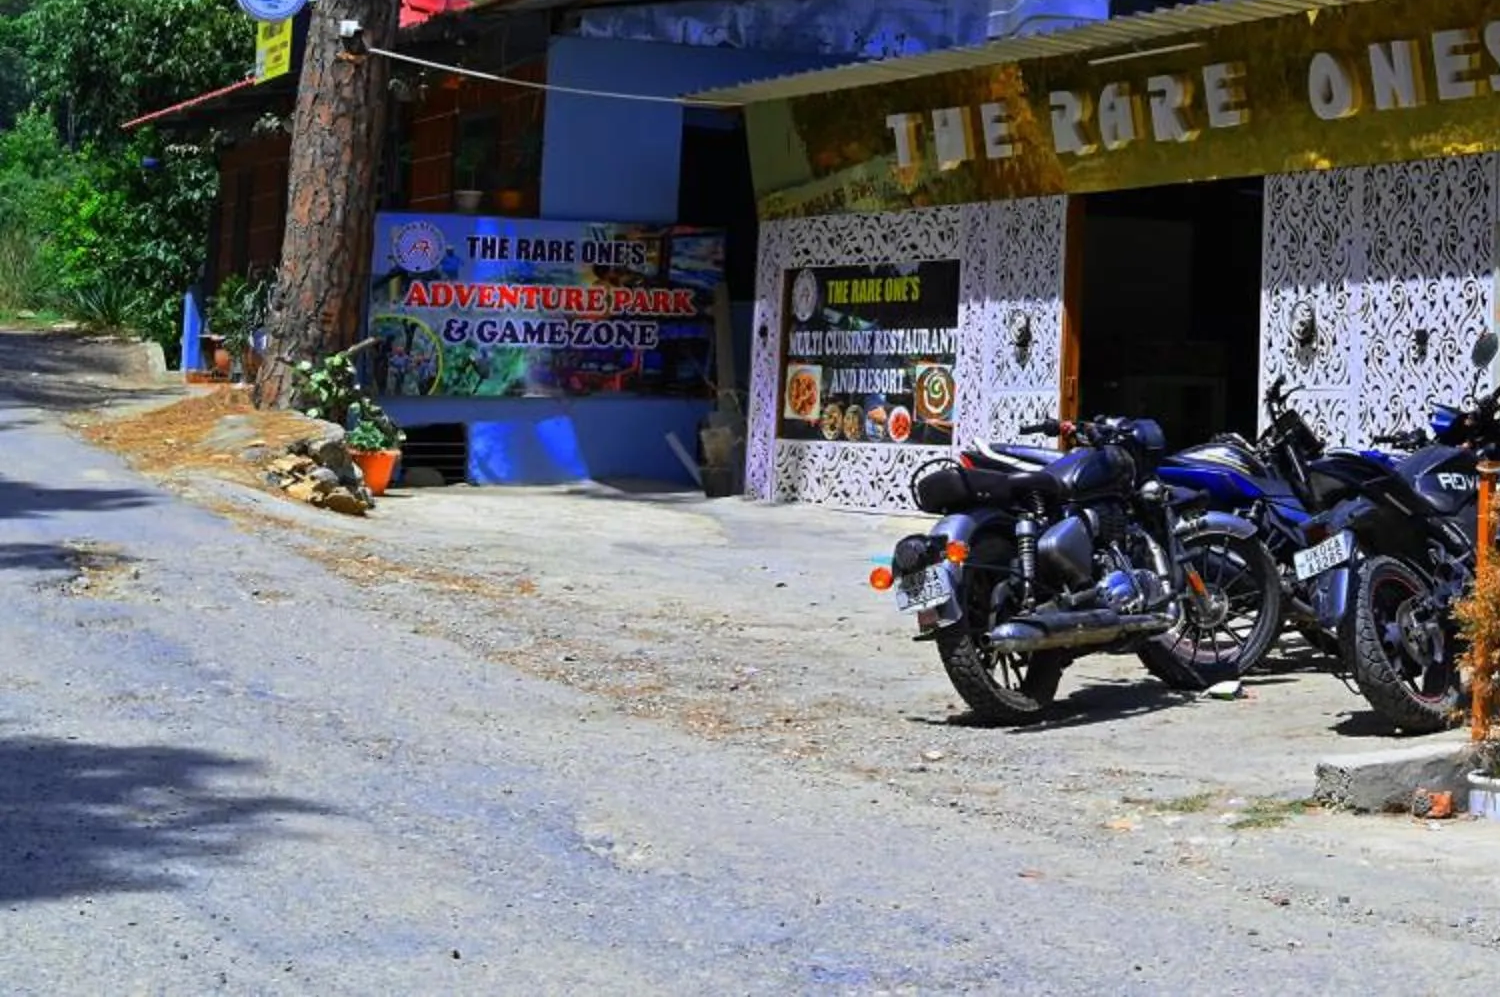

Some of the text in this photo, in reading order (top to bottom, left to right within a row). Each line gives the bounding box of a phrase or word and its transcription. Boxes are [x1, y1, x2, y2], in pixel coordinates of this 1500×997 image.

[886, 101, 1018, 170] THE
[1049, 62, 1249, 155] RARE
[467, 235, 509, 261] THE
[515, 237, 575, 263] RARE
[582, 240, 645, 266] ONE'S
[405, 281, 697, 316] ADVENTURE PARK
[826, 279, 849, 304] THE
[850, 278, 883, 304] RARE
[884, 275, 920, 302] ONE'S
[443, 319, 657, 348] & GAME ZONE
[790, 327, 957, 355] MULTI CUISINE RESTAURANT
[831, 367, 905, 394] AND RESORT
